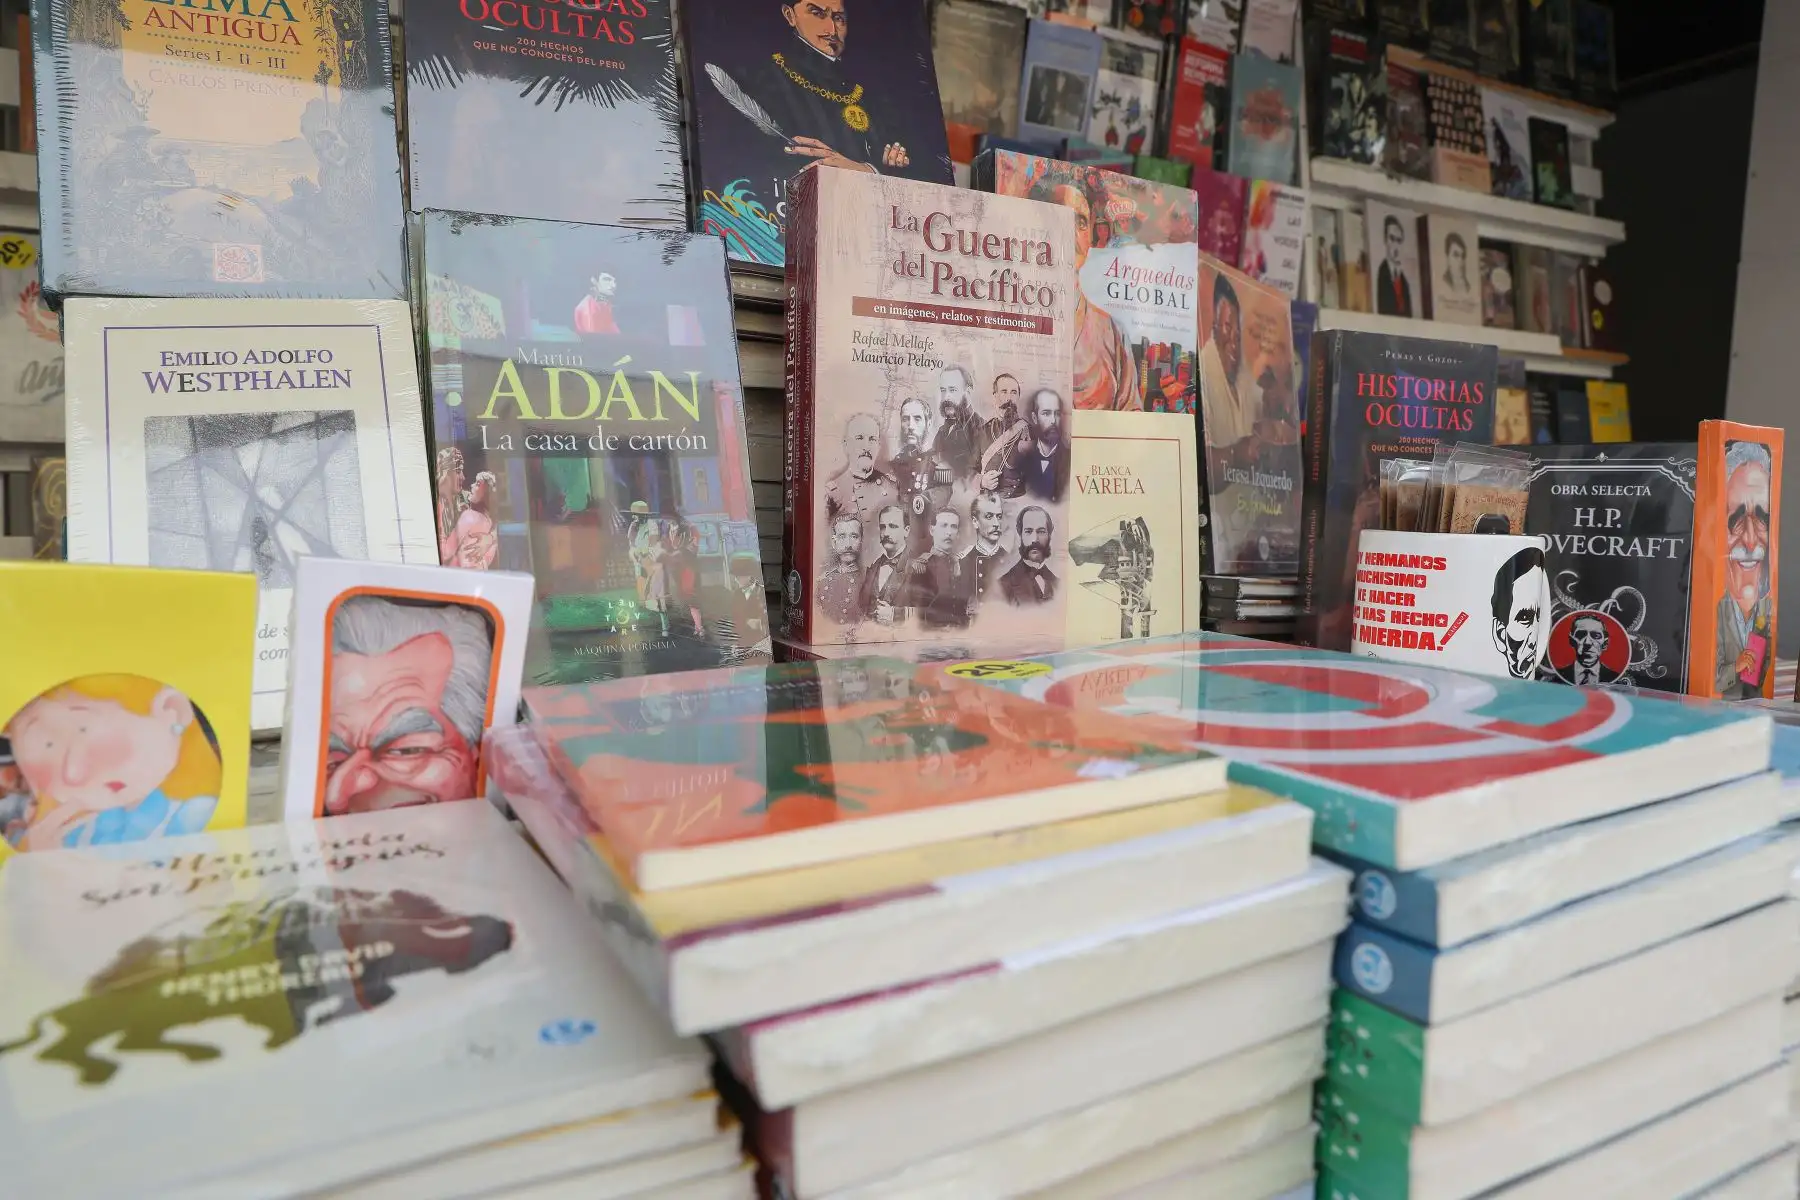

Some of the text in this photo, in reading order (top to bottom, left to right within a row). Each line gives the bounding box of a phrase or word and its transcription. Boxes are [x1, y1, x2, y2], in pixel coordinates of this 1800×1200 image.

[143, 6, 303, 46] ANTIGUA
[460, 0, 635, 45] OCULTAS
[165, 44, 210, 61] Series
[473, 41, 497, 51] QUE
[501, 44, 517, 54] NO
[521, 48, 573, 62] CONOCES
[577, 56, 596, 66] DEL
[517, 37, 584, 54] 200 HECHOS
[891, 205, 1054, 266] La Guerra
[892, 251, 1054, 308] del Pacífico
[1104, 256, 1195, 290] Arguedas
[1107, 282, 1190, 310] GLOBAL
[874, 302, 1036, 329] en imágenes, relatos y testimonios
[852, 330, 934, 352] Rafael Mellafe
[160, 348, 333, 367] EMILIO ADOLFO
[852, 348, 944, 371] Mauricio Pelayo
[142, 369, 353, 394] WESTPHALEN
[477, 355, 703, 422] ADÁN
[786, 375, 794, 403] del
[1357, 372, 1484, 405] HISTORIAS
[1365, 402, 1474, 432] OCULTAS
[481, 424, 708, 450] La casa de cartón
[785, 411, 794, 481] Guerra
[1412, 437, 1440, 445] HECHOS
[1400, 446, 1432, 454] CONOCES
[1091, 465, 1132, 476] BLANCA
[1221, 459, 1293, 496] Teresa Izquierdo
[1076, 475, 1145, 495] VARELA
[1551, 484, 1652, 496] OBRA SELECTA
[784, 489, 792, 513] La
[1573, 507, 1622, 528] H.P.
[1537, 533, 1684, 559] OVECRAFT
[1365, 551, 1447, 570] HERMANOS
[1369, 589, 1416, 607] HACER
[1362, 606, 1385, 623] HAS
[1390, 610, 1449, 628] HECHO
